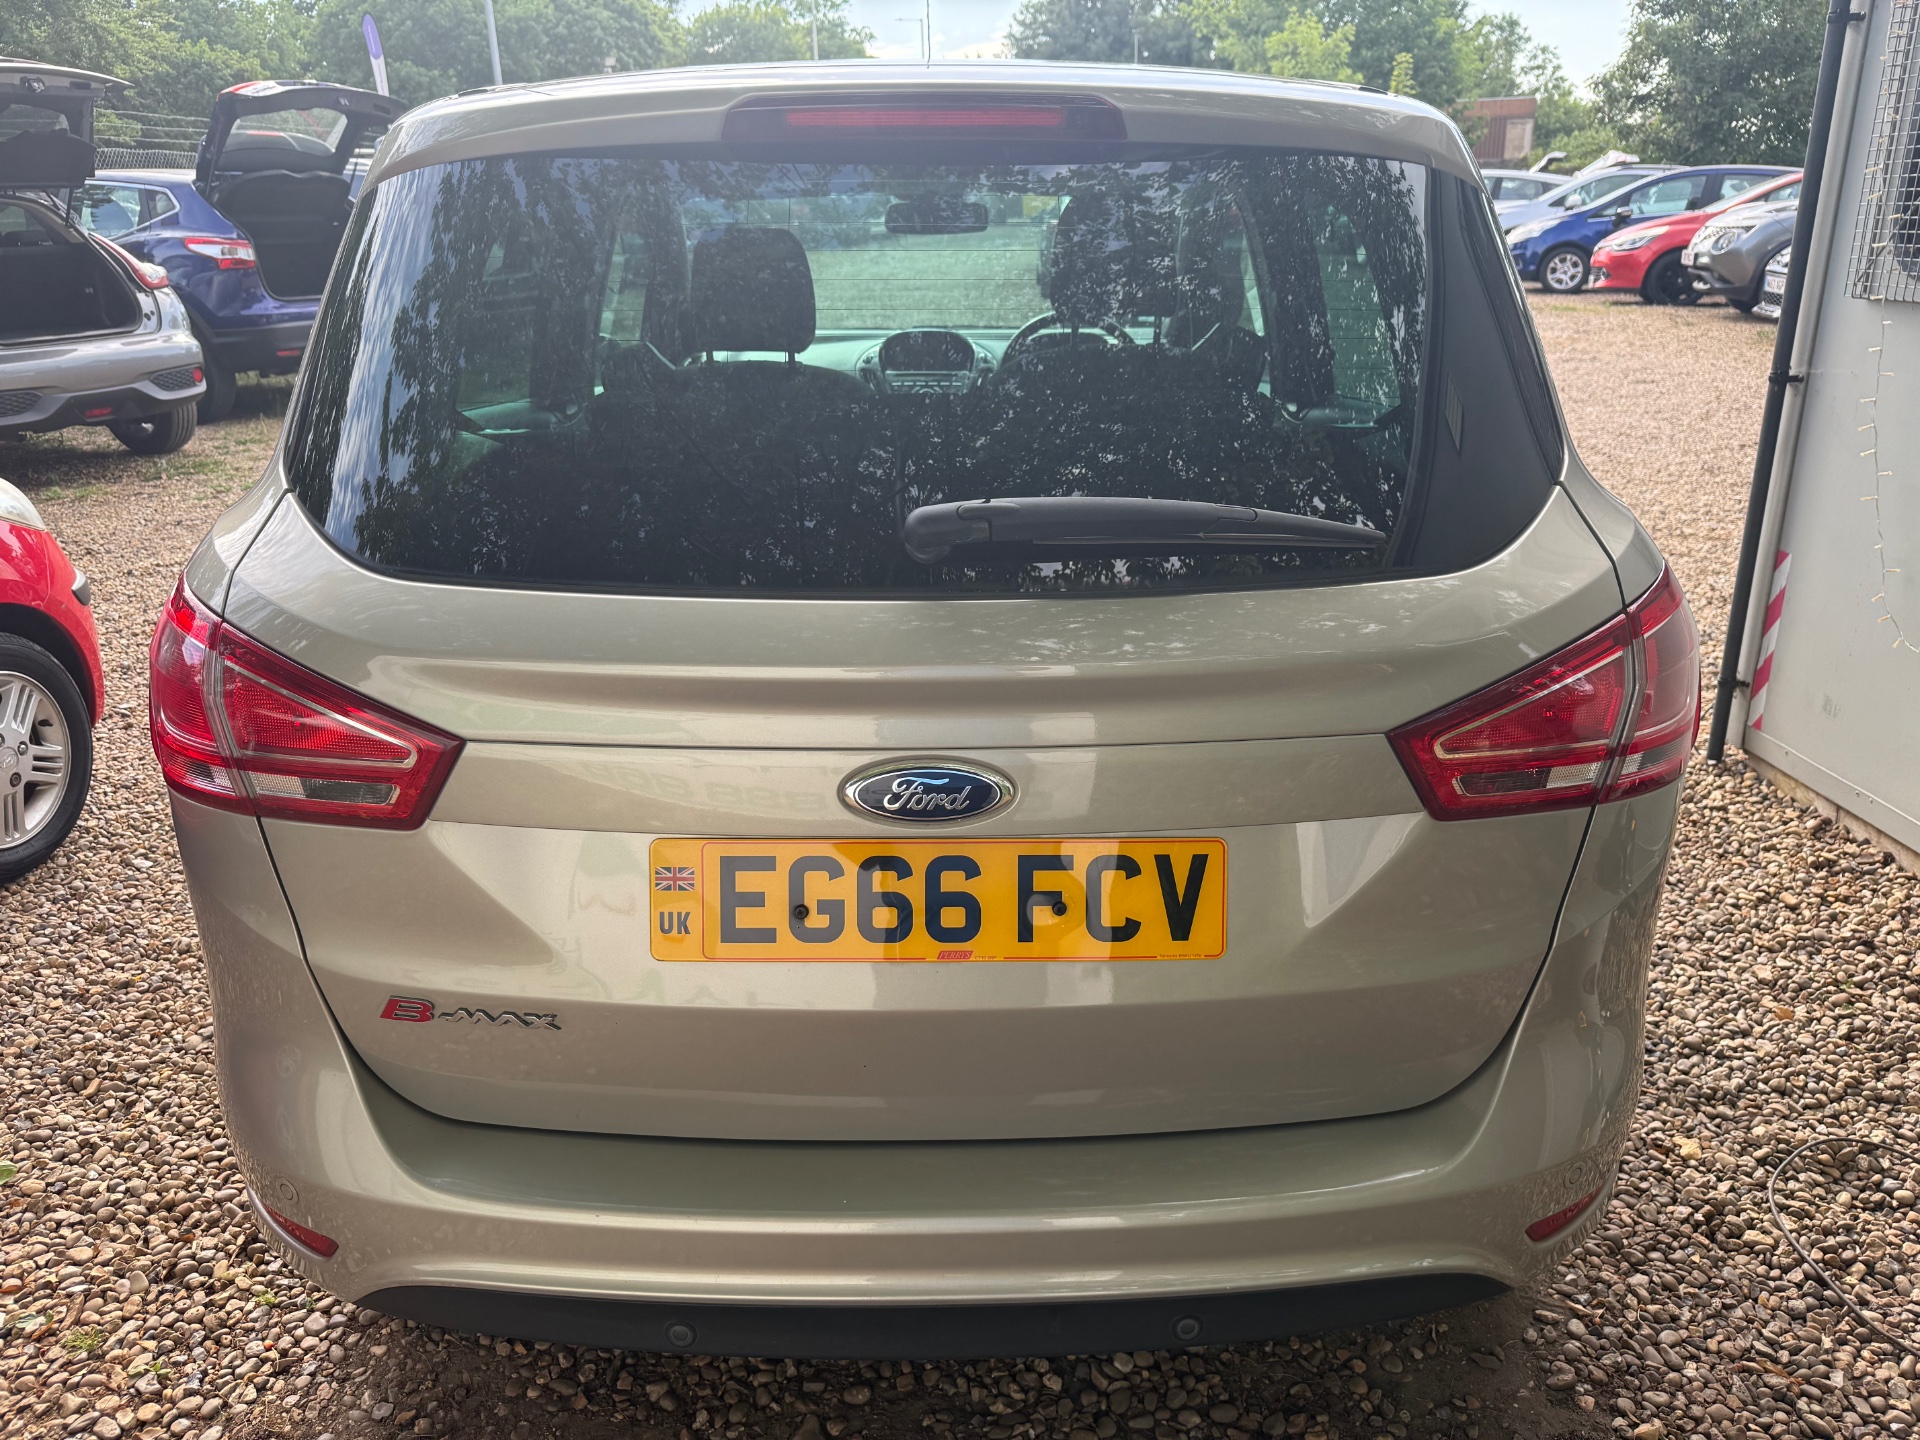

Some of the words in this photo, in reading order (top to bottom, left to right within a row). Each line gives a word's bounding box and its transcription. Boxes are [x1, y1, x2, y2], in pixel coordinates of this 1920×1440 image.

[883, 776, 972, 811] Ford
[719, 855, 982, 944] EG66
[1018, 853, 1209, 943] FCV
[659, 911, 691, 935] UK
[938, 951, 972, 960] PERRYS
